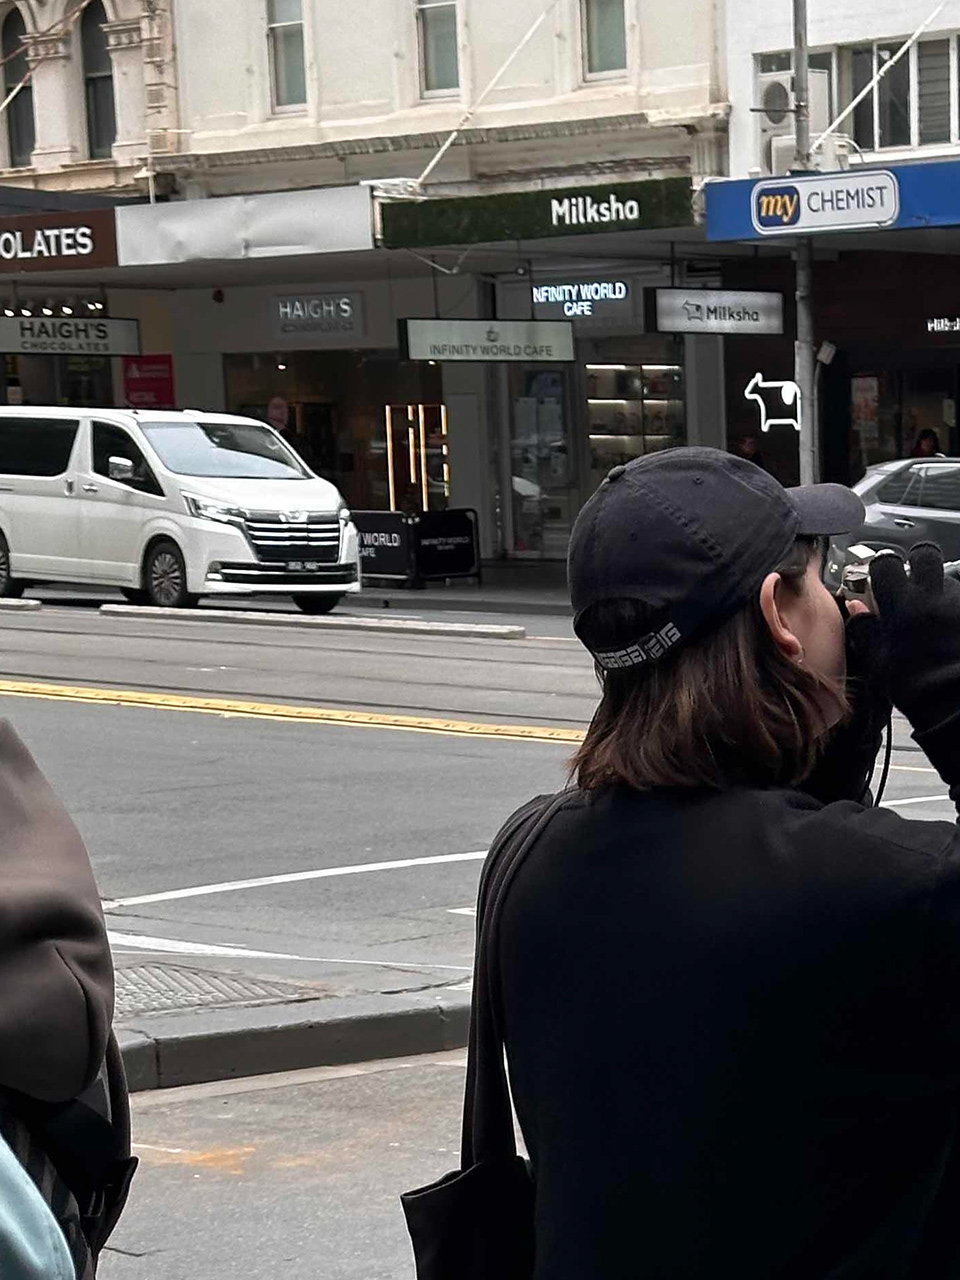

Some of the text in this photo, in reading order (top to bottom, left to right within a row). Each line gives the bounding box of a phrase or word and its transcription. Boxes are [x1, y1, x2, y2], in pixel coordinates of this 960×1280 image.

[551, 194, 640, 226] Milksha
[759, 186, 888, 223] my CHEMIST
[532, 282, 627, 302] NFINITY WORLD
[278, 298, 352, 319] HAIGH'S
[563, 301, 592, 316] CAFE
[706, 306, 759, 323] Milksha
[20, 321, 108, 339] HAIGH'S
[21, 340, 110, 351] CHOCOLATES
[429, 345, 553, 357] INFINITY WORLD CAFE
[362, 533, 400, 546] WORLD
